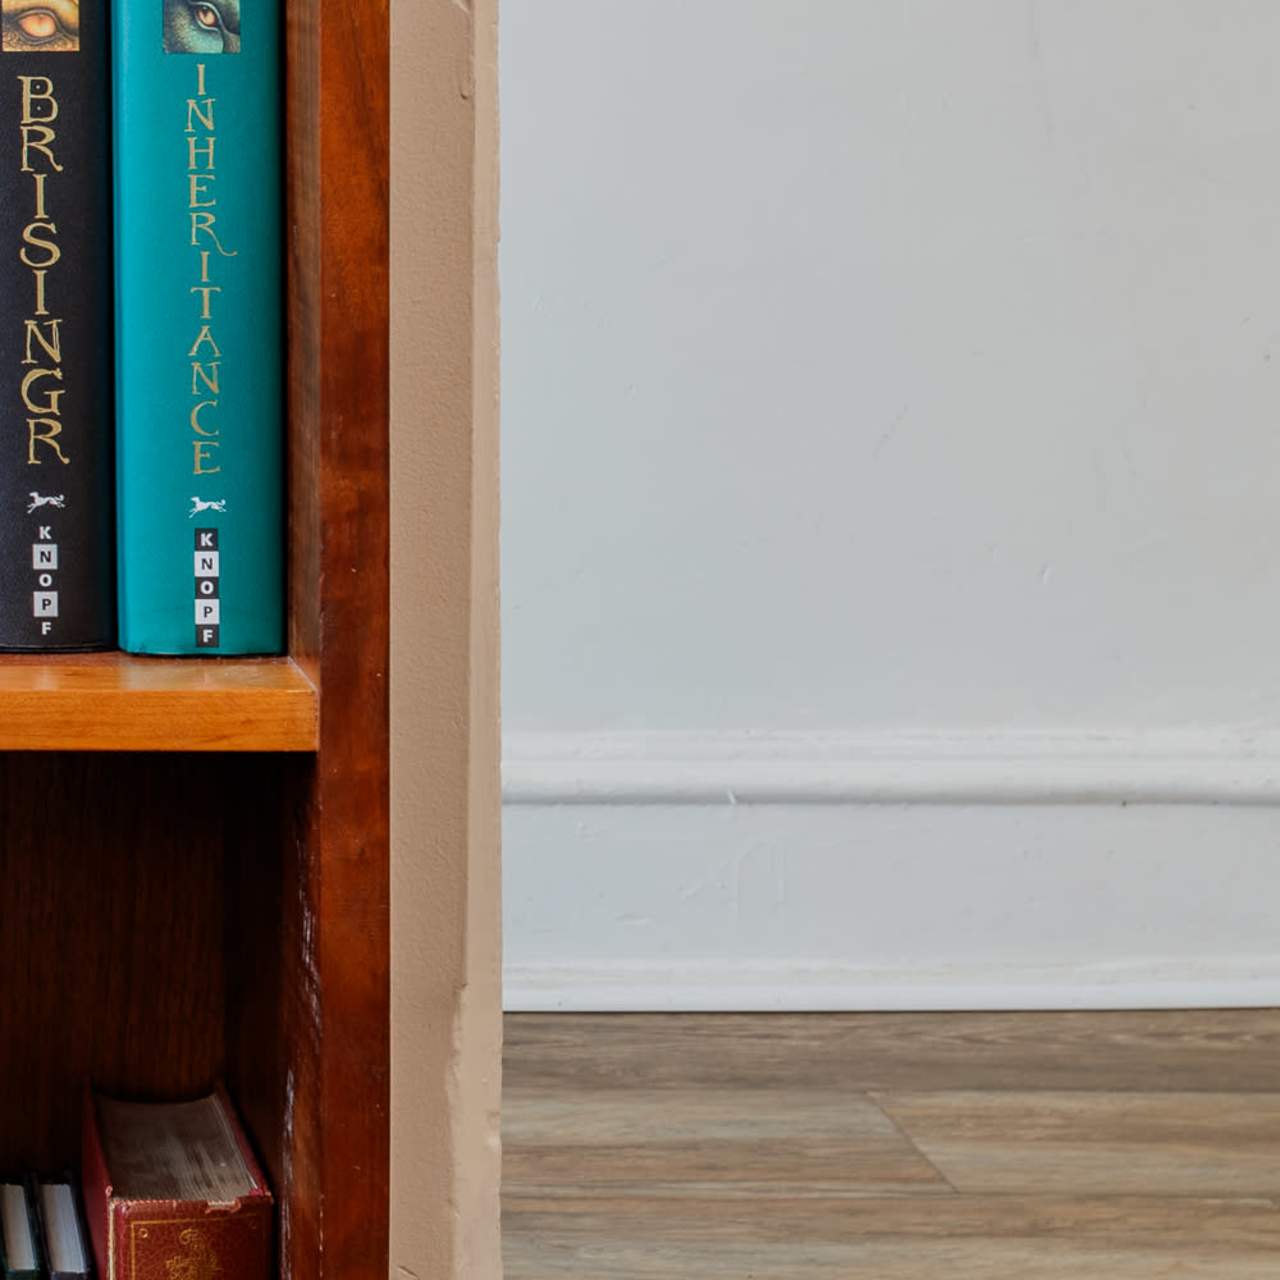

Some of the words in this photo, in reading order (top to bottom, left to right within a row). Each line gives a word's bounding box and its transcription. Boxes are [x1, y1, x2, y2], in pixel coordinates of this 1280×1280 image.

[16, 75, 71, 465] BRISINGR
[183, 63, 238, 475] INHERITANCE
[38, 525, 54, 635] KNOPF
[198, 532, 216, 643] KNOPF
